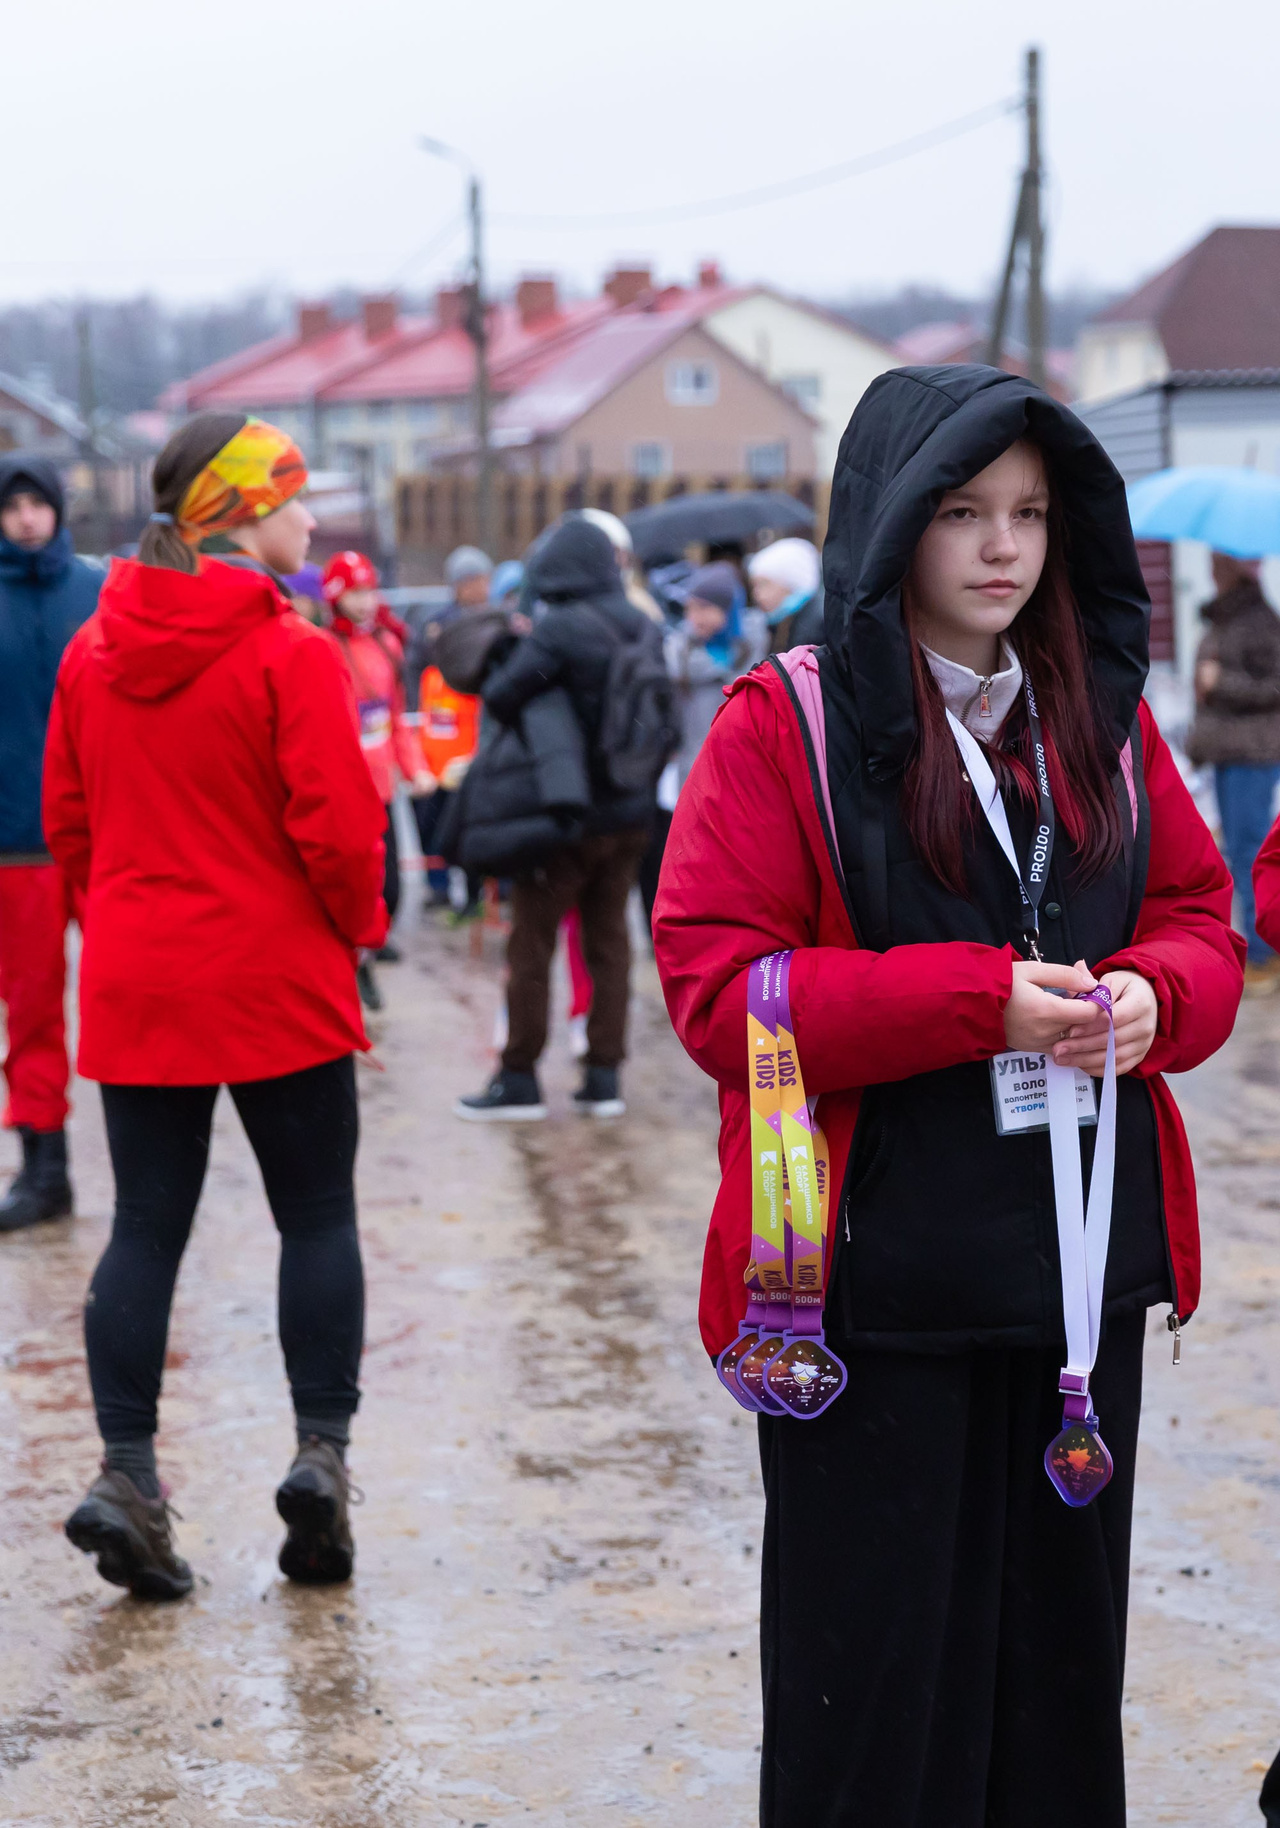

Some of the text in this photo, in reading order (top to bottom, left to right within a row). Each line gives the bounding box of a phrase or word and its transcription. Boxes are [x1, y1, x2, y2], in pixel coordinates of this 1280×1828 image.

[1035, 743, 1050, 797] PRO100
[1030, 825, 1050, 882] PRO100
[755, 1053, 776, 1090] KIDS
[777, 1049, 797, 1087] KIDS
[1013, 1078, 1048, 1092] ВОЛО
[1010, 1102, 1045, 1114] «ТВОРИ
[762, 1170, 770, 1198] СПОРТ
[794, 1165, 804, 1193] СПОРТ
[800, 1165, 814, 1225] КАЛАШНИКОВ
[769, 1170, 777, 1229] КАЛАШНИКОВ
[797, 1264, 818, 1286] KIDS
